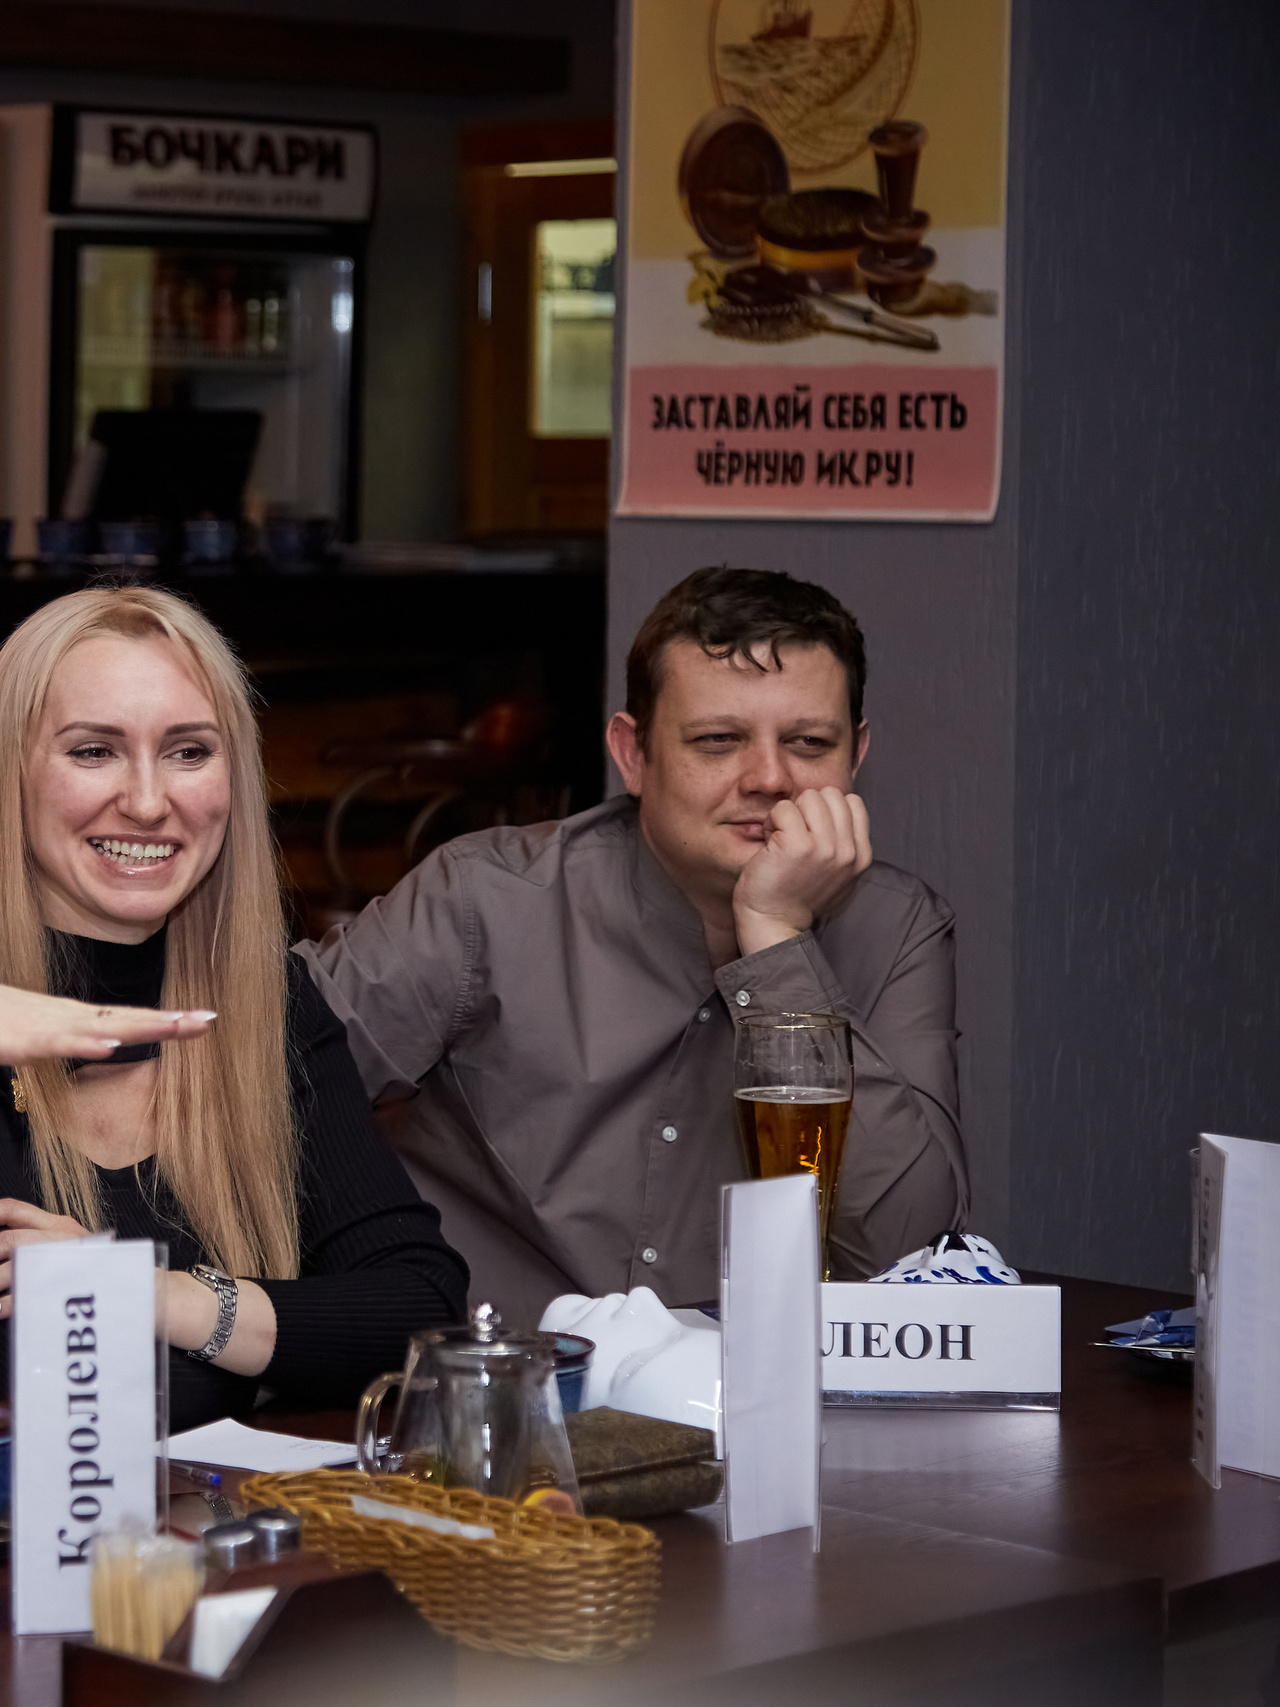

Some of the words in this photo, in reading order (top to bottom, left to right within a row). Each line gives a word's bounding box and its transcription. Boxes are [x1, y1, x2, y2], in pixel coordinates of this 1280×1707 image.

[109, 124, 345, 181] БОЧКАРИ
[652, 385, 812, 431] ЗАСТАВЛЯЙ
[822, 393, 887, 431] СЕБЯ
[898, 393, 969, 431] ЕСТЬ
[696, 441, 806, 487] ЧЁРНУЮ
[816, 449, 915, 488] ИКРУ!
[58, 1292, 115, 1573] Королева
